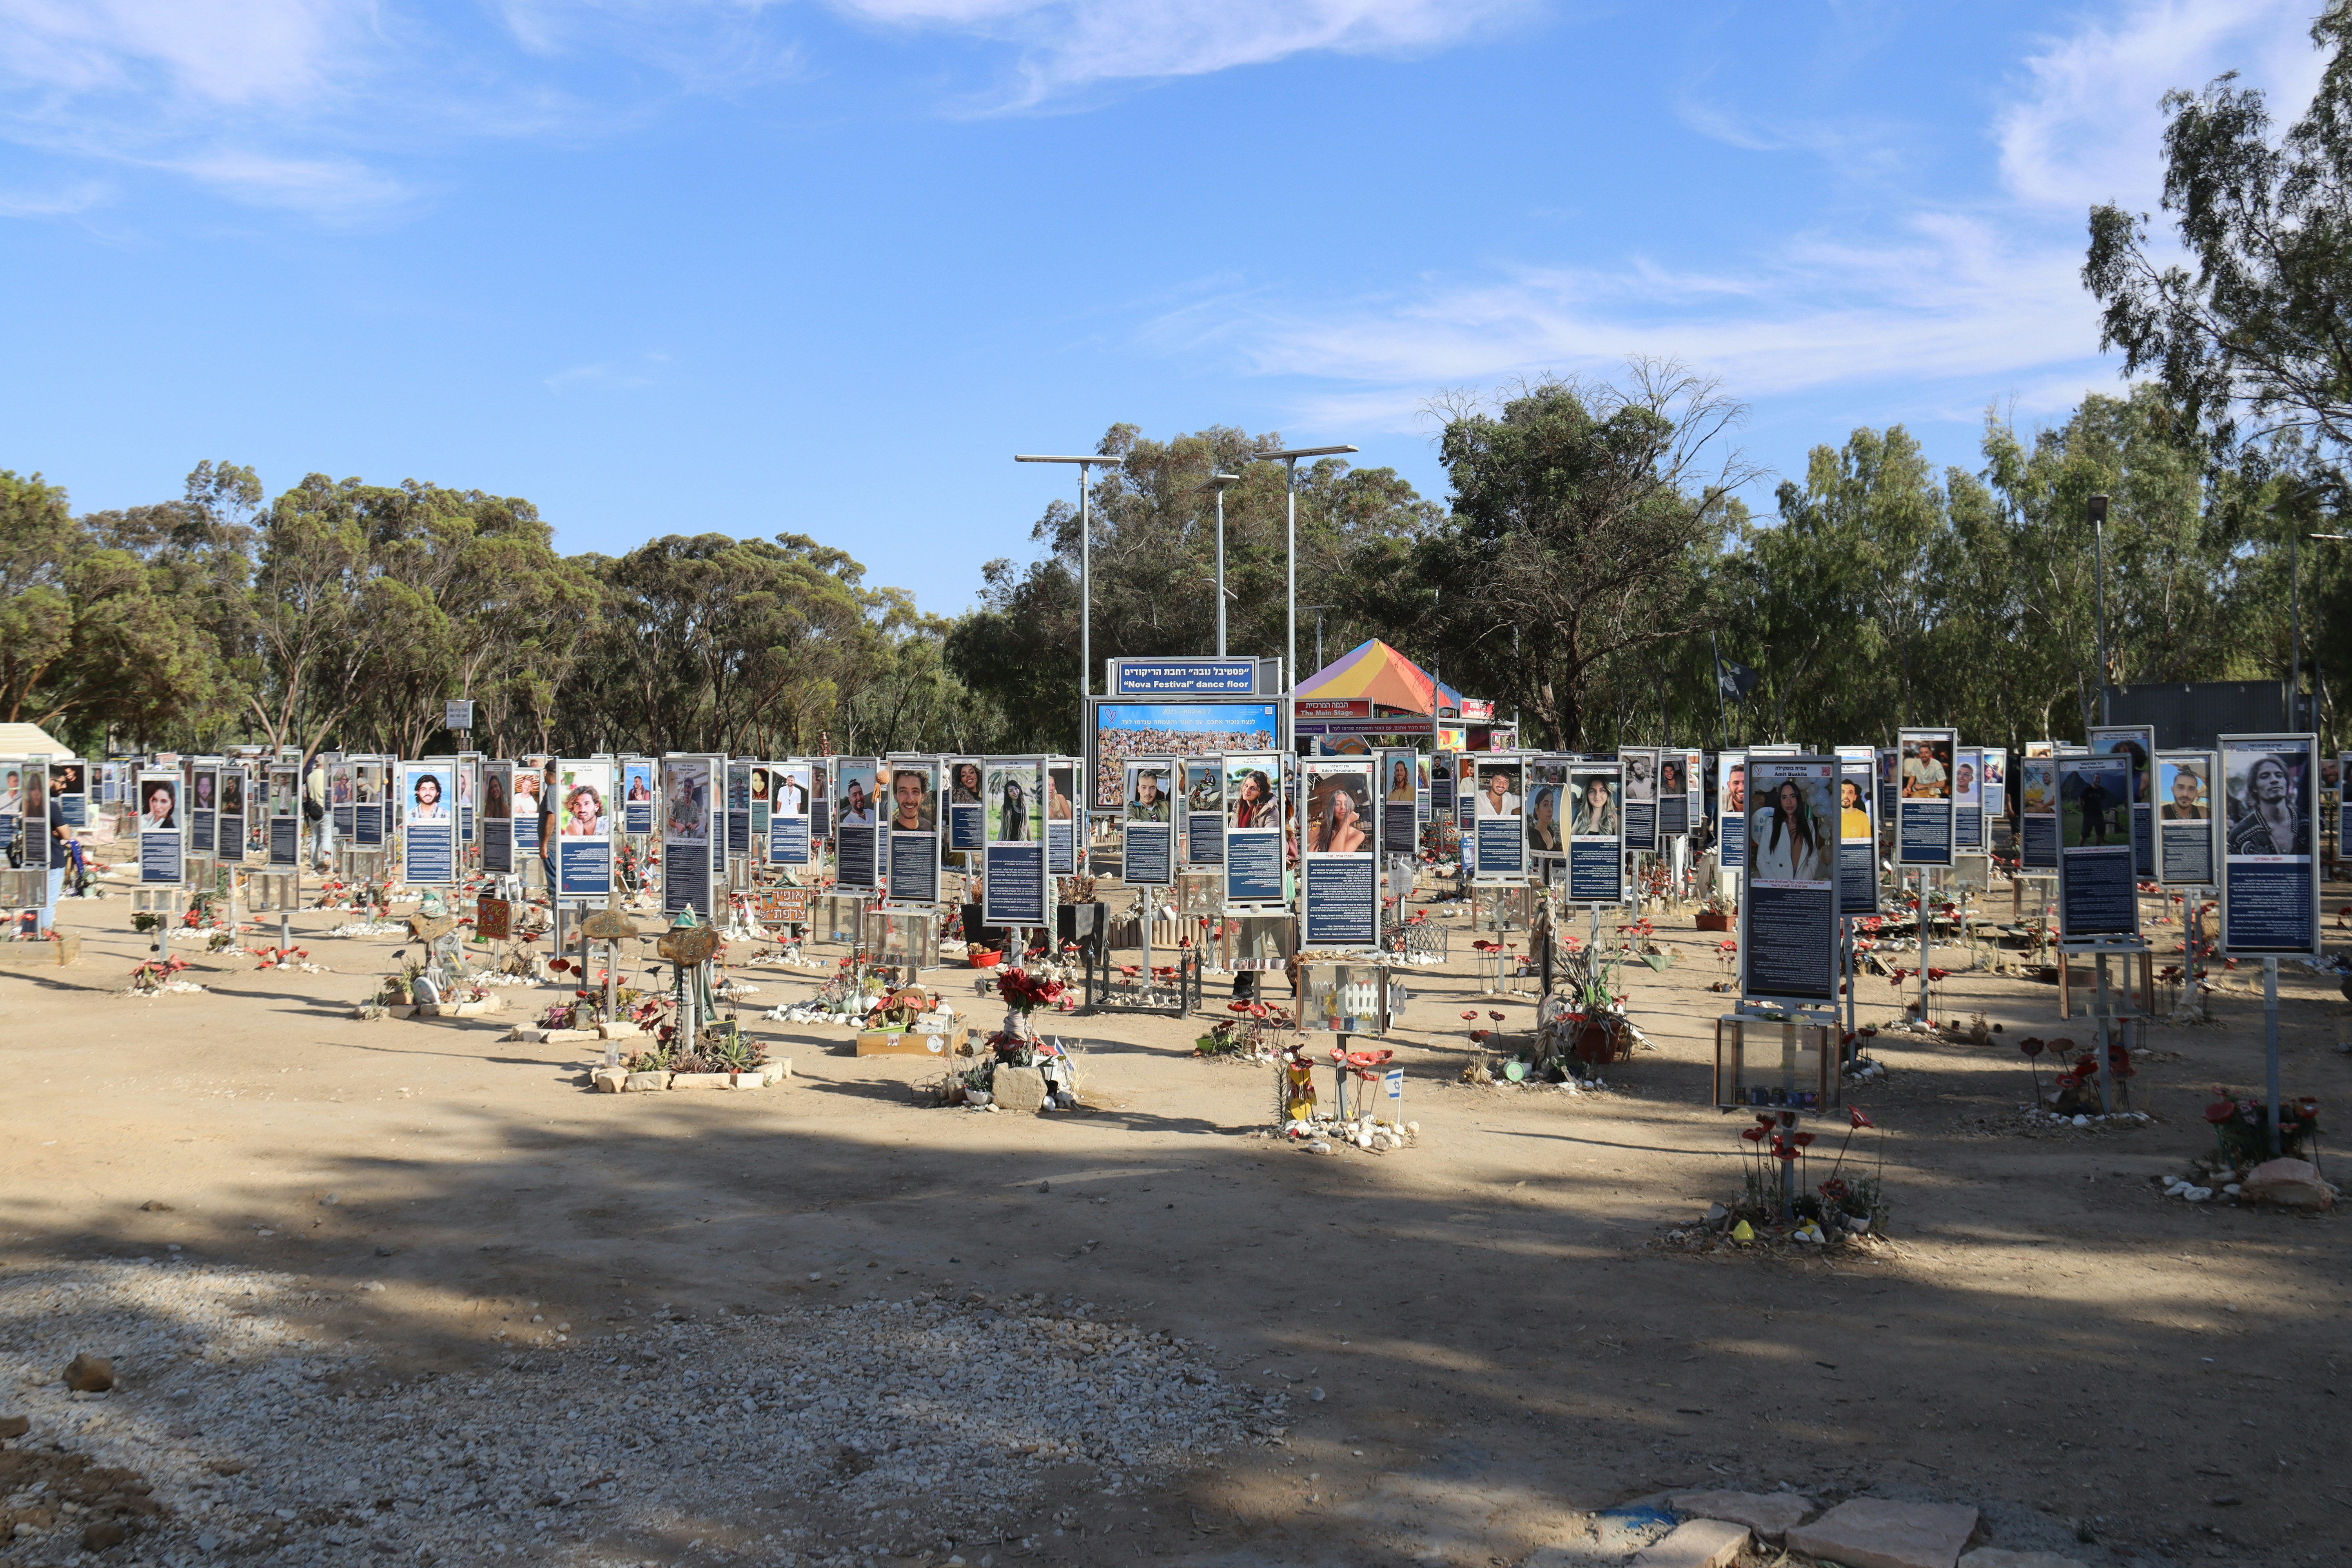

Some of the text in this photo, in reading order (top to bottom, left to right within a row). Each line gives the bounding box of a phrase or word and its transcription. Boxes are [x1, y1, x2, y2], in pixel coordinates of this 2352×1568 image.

[1124, 668, 1161, 677] הריקודים
[772, 890, 804, 900] אופיר
[771, 909, 806, 919] צרפתי
